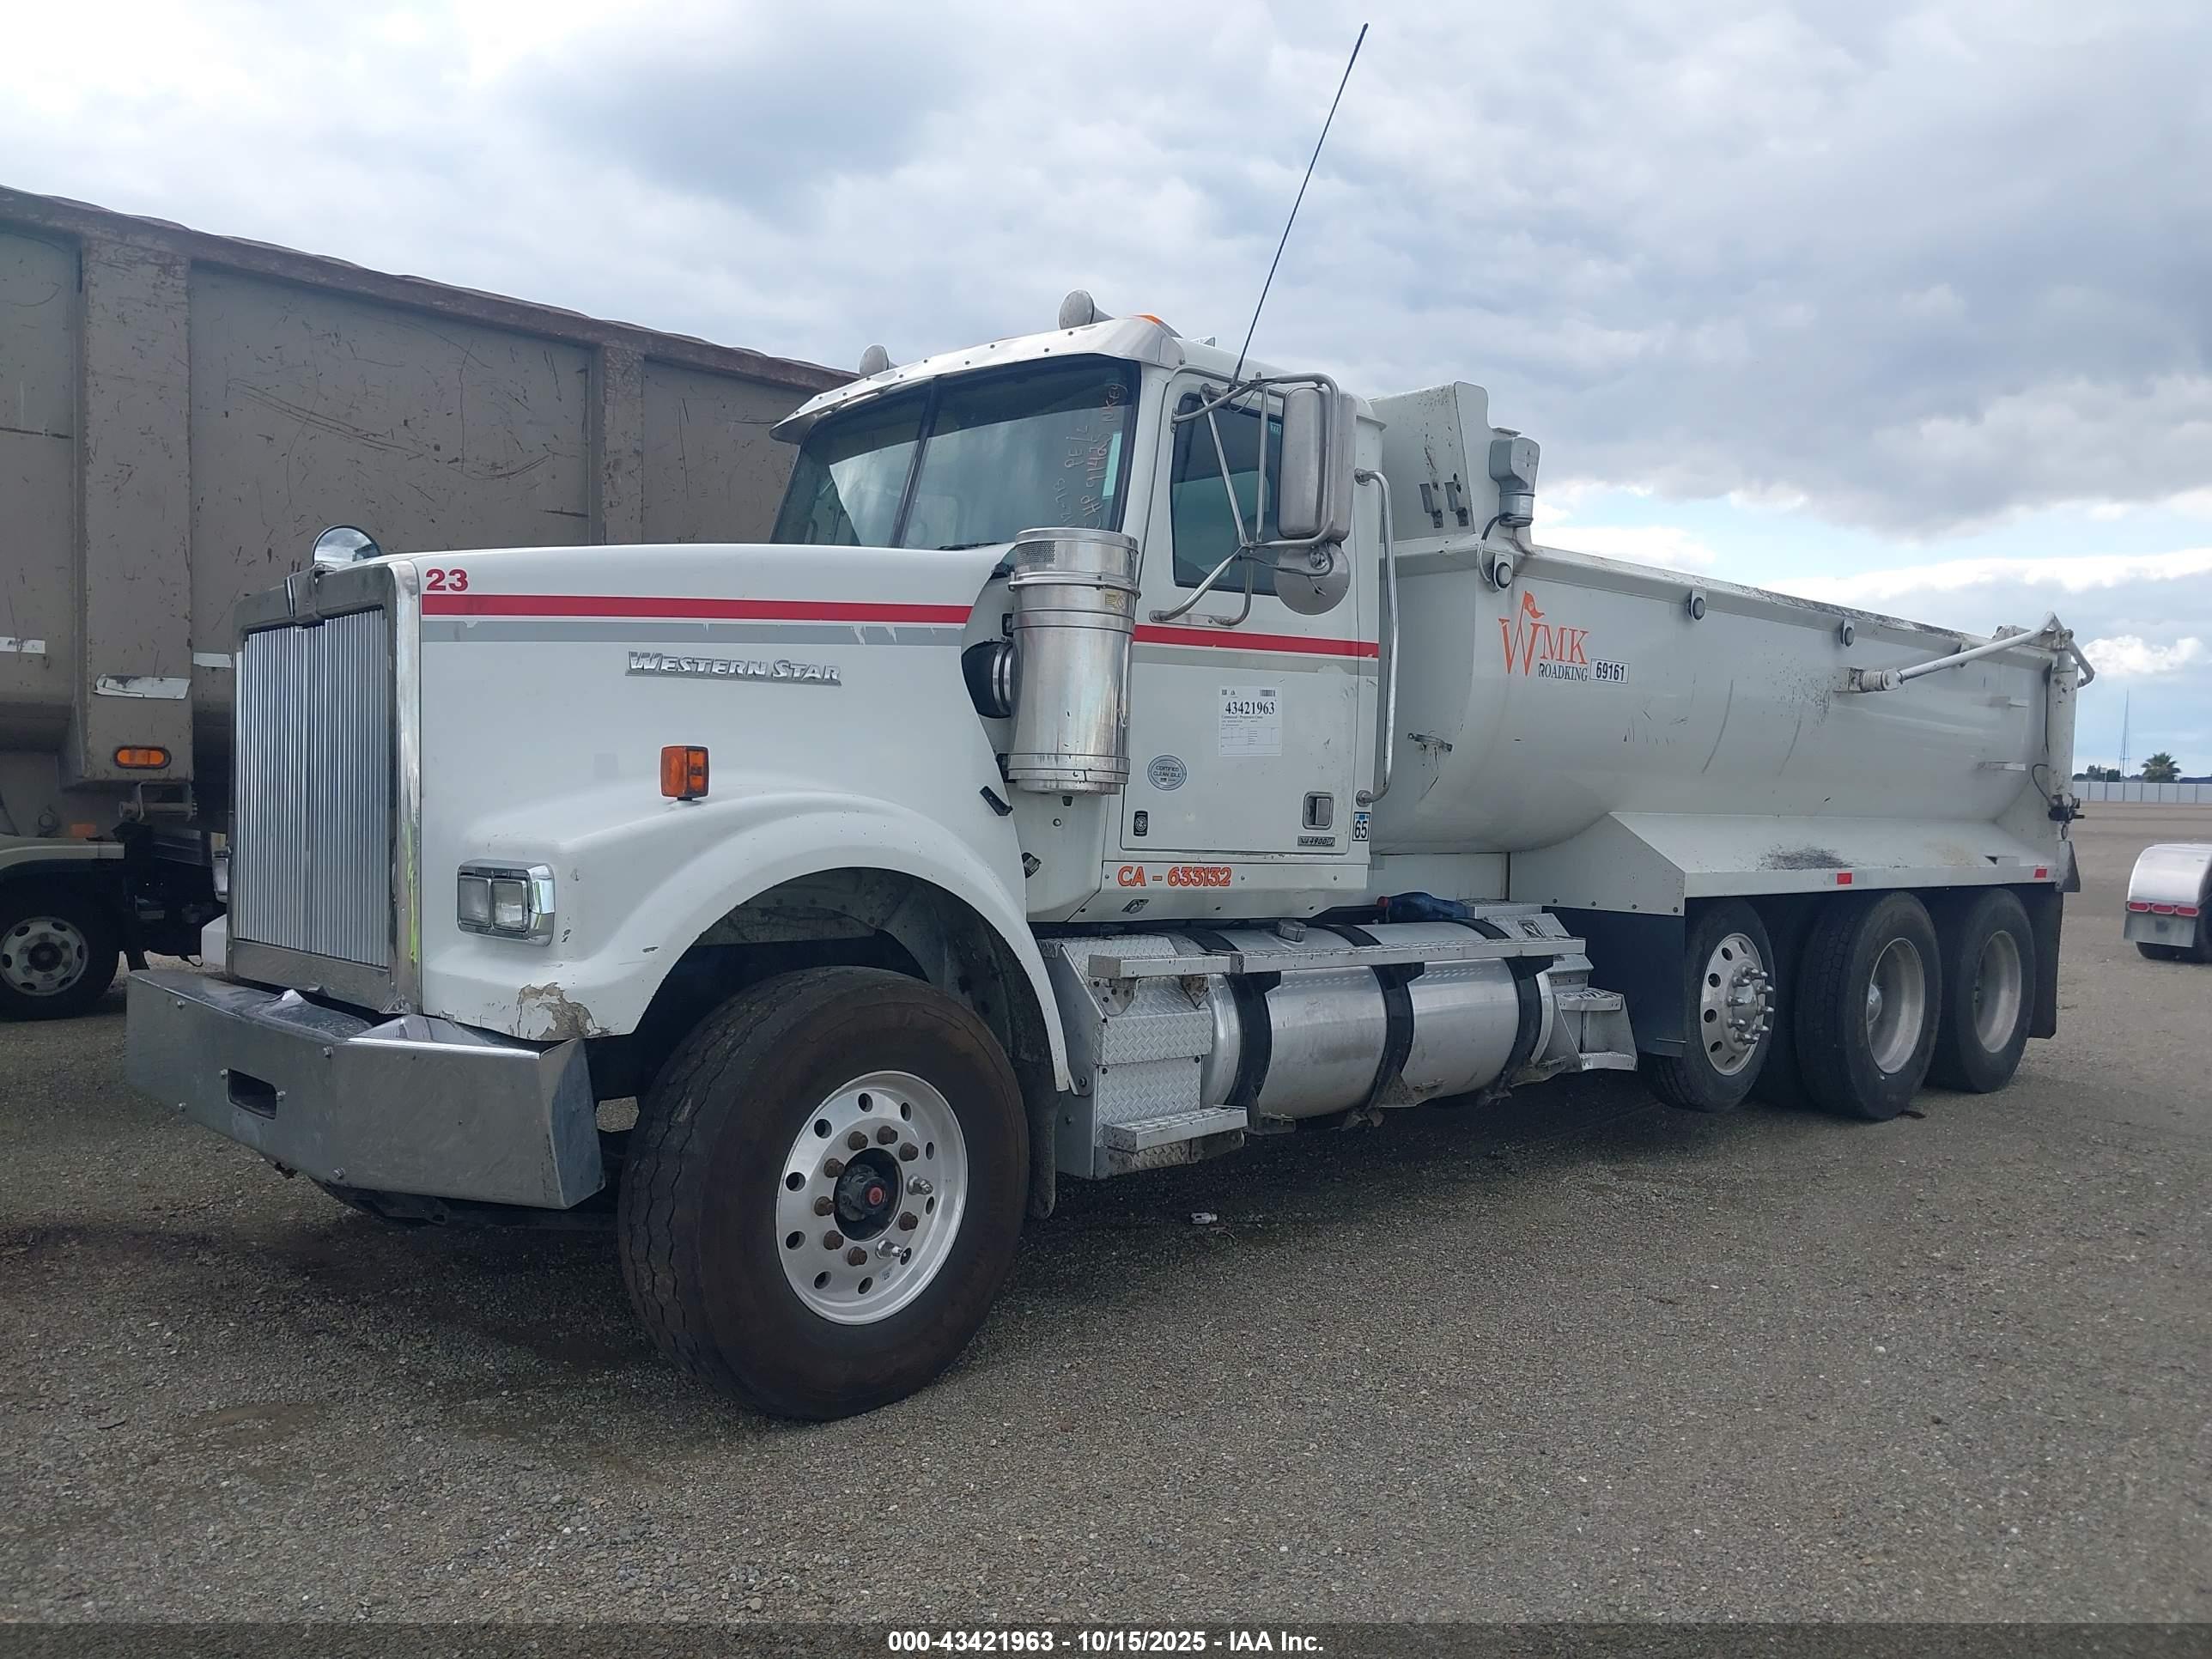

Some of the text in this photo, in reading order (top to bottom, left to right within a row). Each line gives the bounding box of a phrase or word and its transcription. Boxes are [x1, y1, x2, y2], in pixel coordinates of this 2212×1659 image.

[426, 568, 469, 592] 23
[1498, 615, 1589, 677] WMK
[629, 651, 841, 681] WESTERN STAR
[1538, 661, 1625, 682] ROADKING 69161
[1224, 701, 1275, 714] 43421963
[1354, 820, 1368, 839] 65
[1117, 866, 1146, 886] CA
[1167, 866, 1232, 886] 633132
